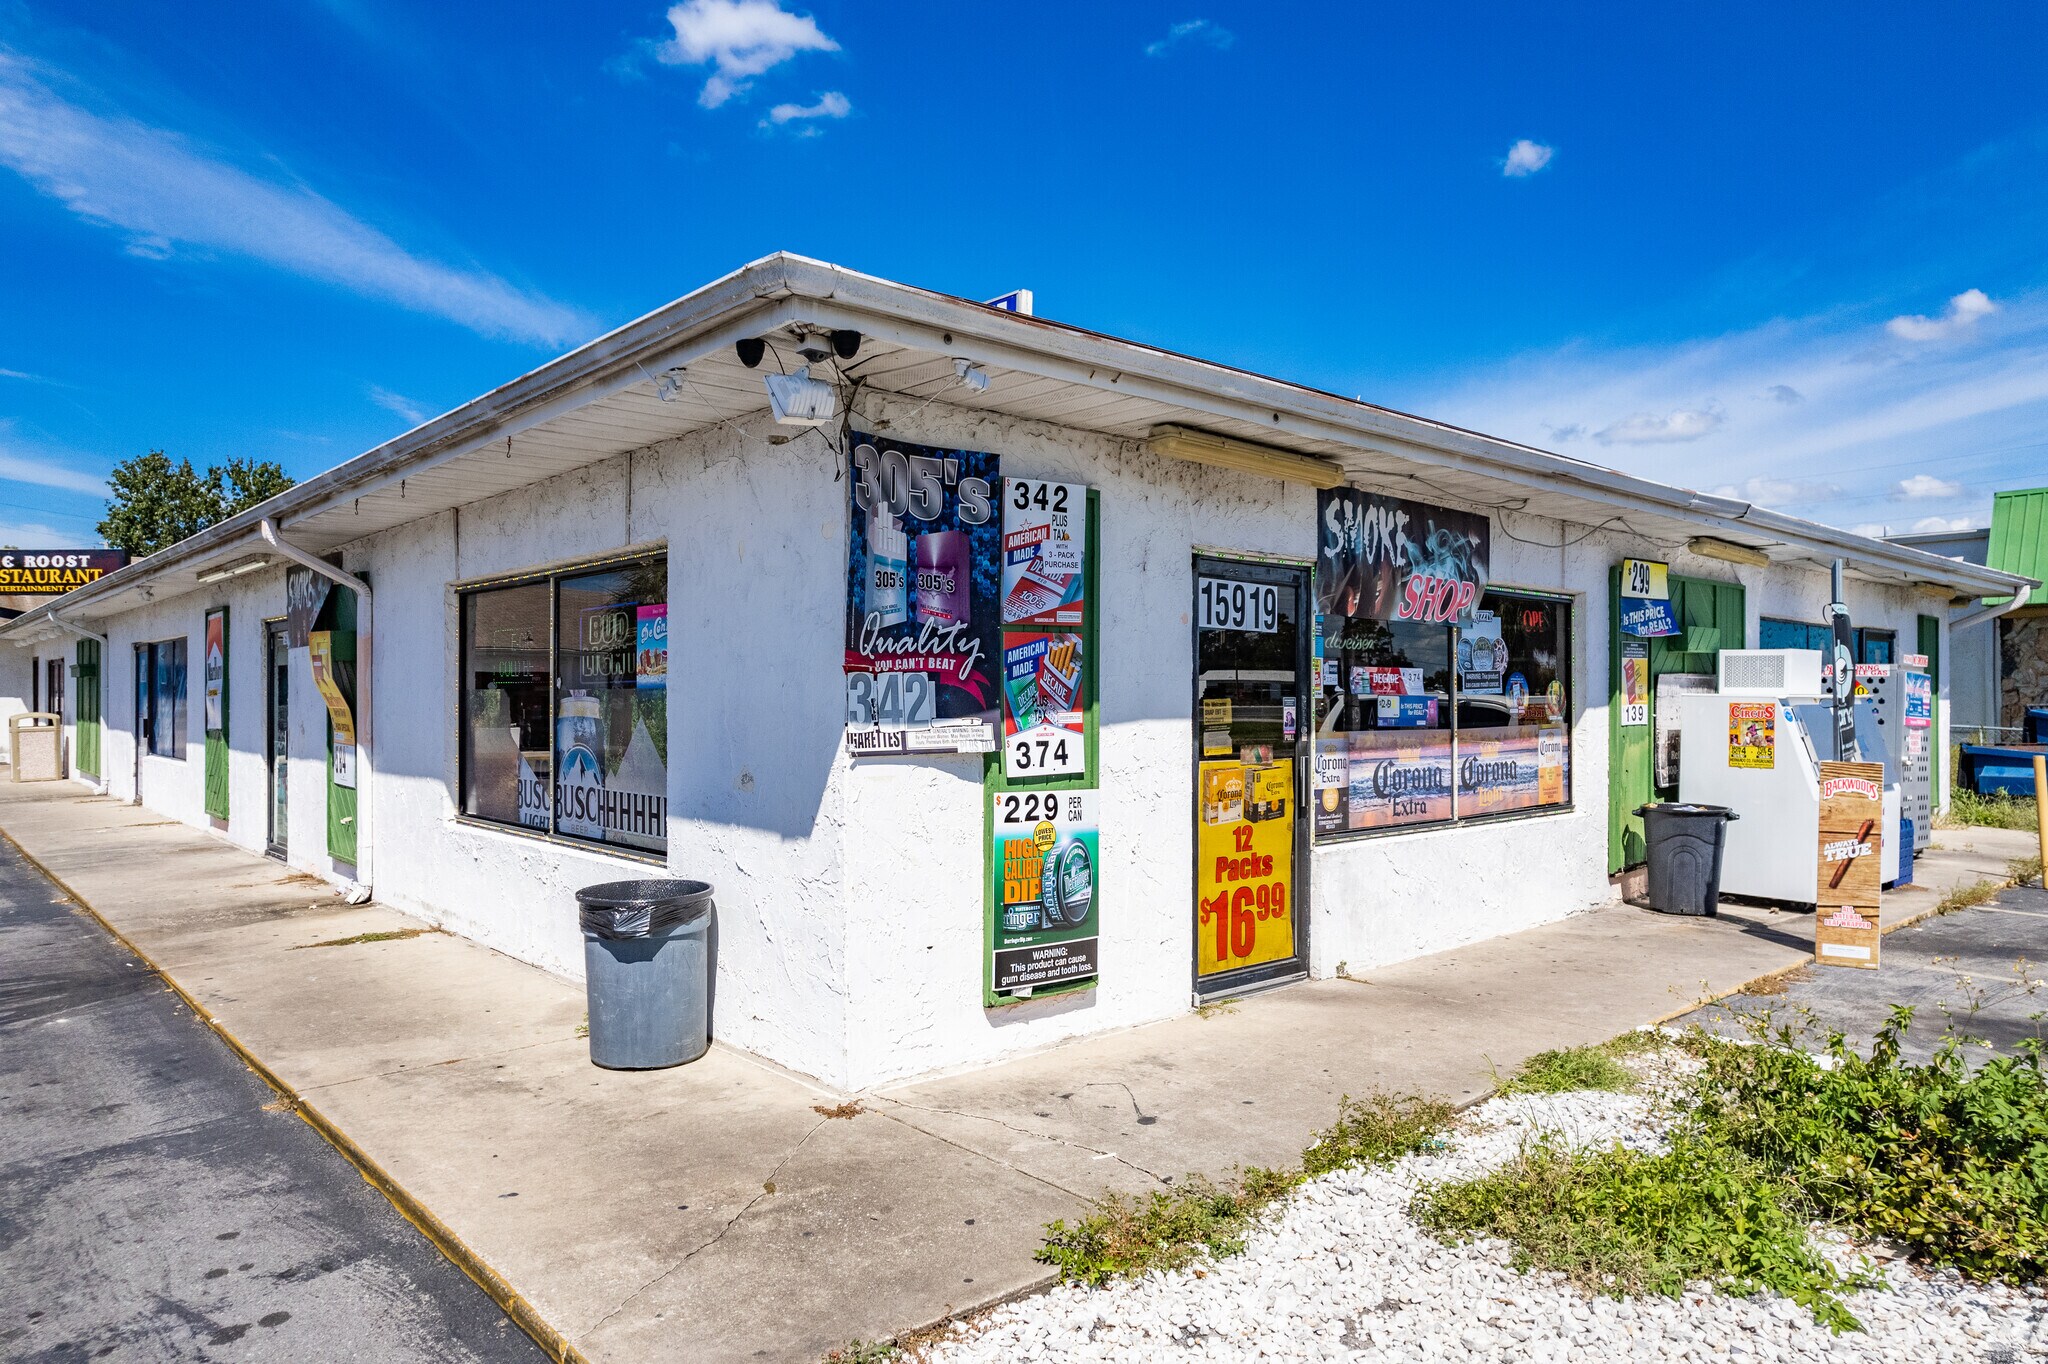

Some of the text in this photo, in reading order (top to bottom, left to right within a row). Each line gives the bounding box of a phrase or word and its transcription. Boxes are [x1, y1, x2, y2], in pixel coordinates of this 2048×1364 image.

[854, 443, 992, 525] 305's
[1051, 514, 1068, 527] PLUS
[1008, 527, 1048, 549] AMERICAN
[1053, 528, 1067, 541] TAX
[1324, 497, 1411, 567] SMOKE
[24, 555, 91, 568] ROOST
[1013, 545, 1035, 562] MADE
[1044, 560, 1079, 569] PURCHASE
[0, 569, 103, 584] STAURANT
[875, 569, 905, 590] 305's
[917, 572, 956, 593] 305's
[1201, 580, 1277, 630] 15919
[1398, 573, 1476, 624] SHOP
[1629, 609, 1645, 623] THIS
[1646, 605, 1665, 620] PRICE
[653, 616, 668, 641] Con
[1638, 617, 1672, 635] for REAL?
[860, 611, 986, 680] Quality
[1007, 640, 1046, 664] AMERICAN
[895, 658, 926, 671] CAN'T
[928, 656, 957, 671] BEAT
[1012, 659, 1034, 678] MADE
[1043, 668, 1068, 701] DECADE
[1372, 673, 1400, 684] DECADE
[1731, 705, 1774, 718] CIRCUS
[1539, 740, 1561, 756] Corona
[1315, 754, 1347, 775] Corona
[1460, 755, 1518, 791] Corona
[1266, 781, 1284, 792] Corona
[1320, 771, 1341, 784] Extra
[1372, 757, 1443, 800] Corona
[518, 778, 550, 811] BUSC
[1217, 788, 1242, 802] Corona
[1477, 785, 1504, 808] Light
[1825, 778, 1878, 799] BACKWOODS
[1068, 796, 1082, 808] PER
[1388, 797, 1427, 818] Extra
[1068, 809, 1082, 822] CAN
[570, 824, 589, 834] BEER
[1036, 827, 1054, 837] LOWEST
[1038, 834, 1052, 842] PRICE
[1233, 824, 1253, 853] 12
[1004, 838, 1044, 859] HIGH
[1823, 842, 1873, 862] TRUE
[1824, 838, 1859, 850] ALWAYS
[1004, 858, 1042, 881] CALIBER
[1215, 852, 1274, 884] Packs
[1004, 879, 1041, 904] DIP
[1833, 913, 1862, 921] NATURAL
[1842, 920, 1872, 929] WRAPPER
[1032, 947, 1069, 960] WARNING:
[1010, 955, 1087, 973] This product can cause
[1001, 962, 1093, 986] gum disease and tooth loss.
